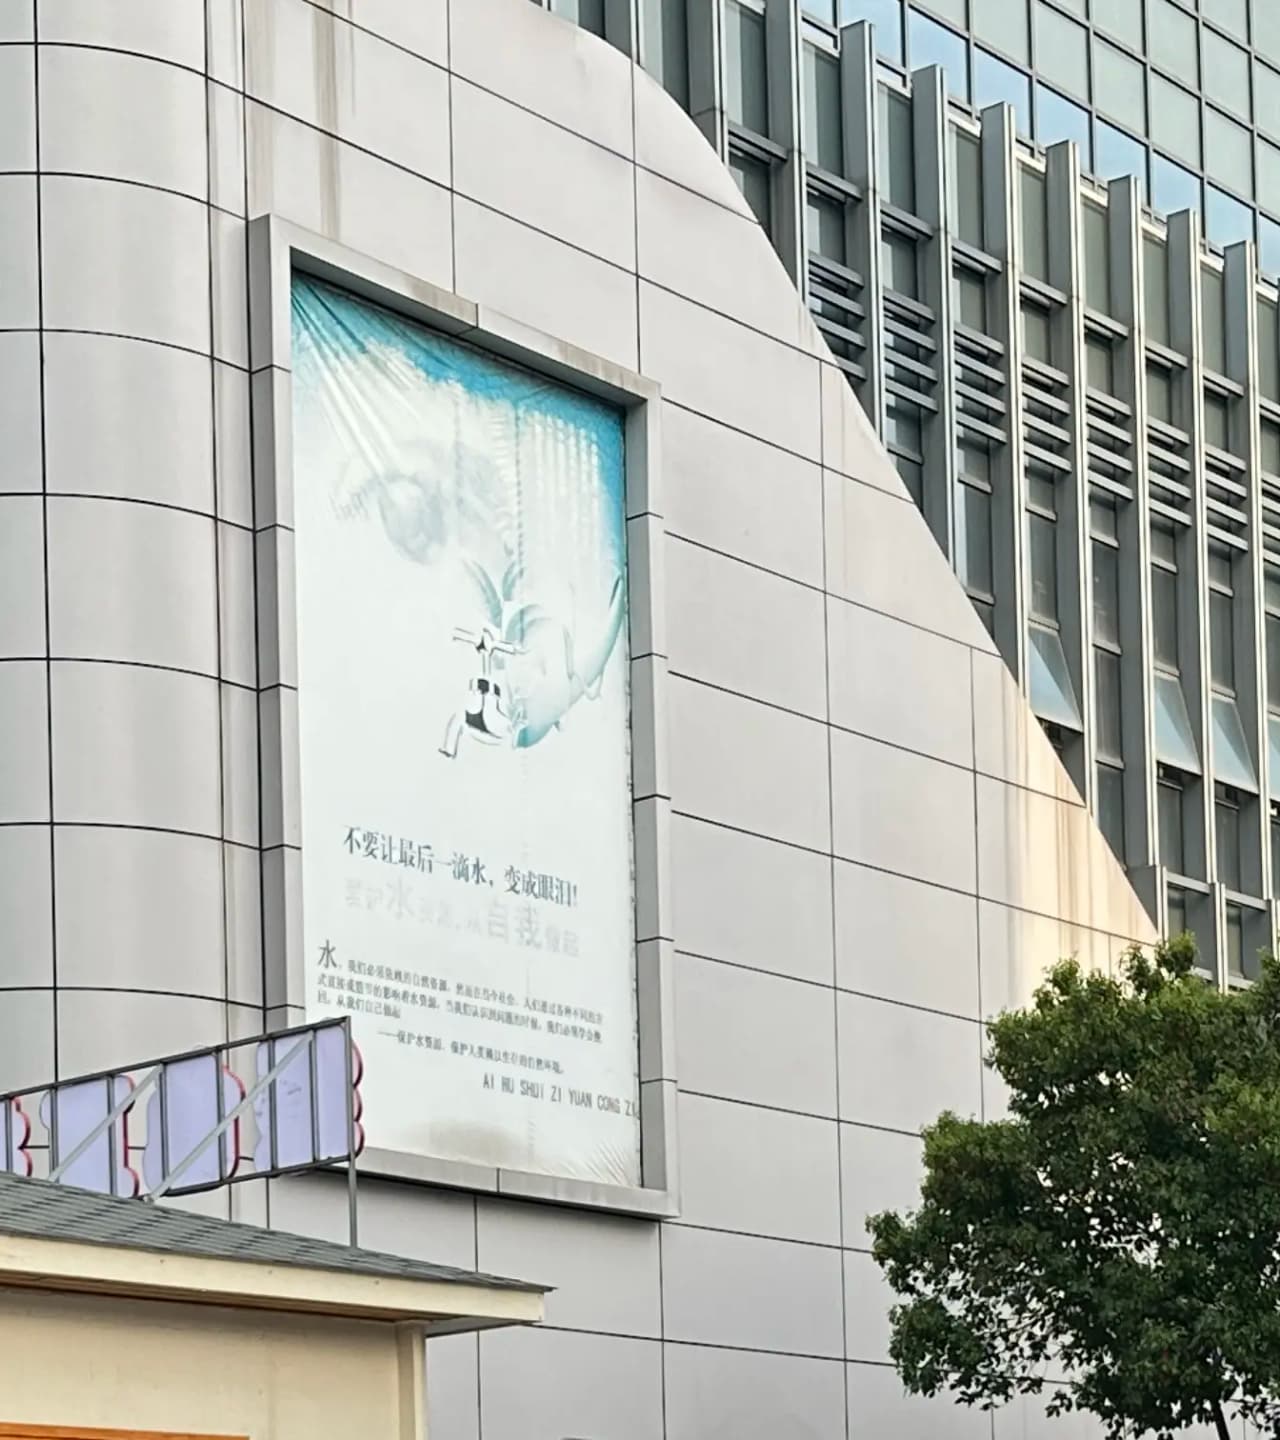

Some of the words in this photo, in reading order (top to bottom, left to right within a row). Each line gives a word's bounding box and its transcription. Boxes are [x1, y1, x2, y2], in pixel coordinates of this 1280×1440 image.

[483, 1073, 495, 1089] AI
[501, 1077, 515, 1094] HU
[519, 1080, 545, 1100] SHUI
[550, 1086, 563, 1102] ZI
[568, 1089, 593, 1109] YUAN
[596, 1095, 621, 1115] CONG
